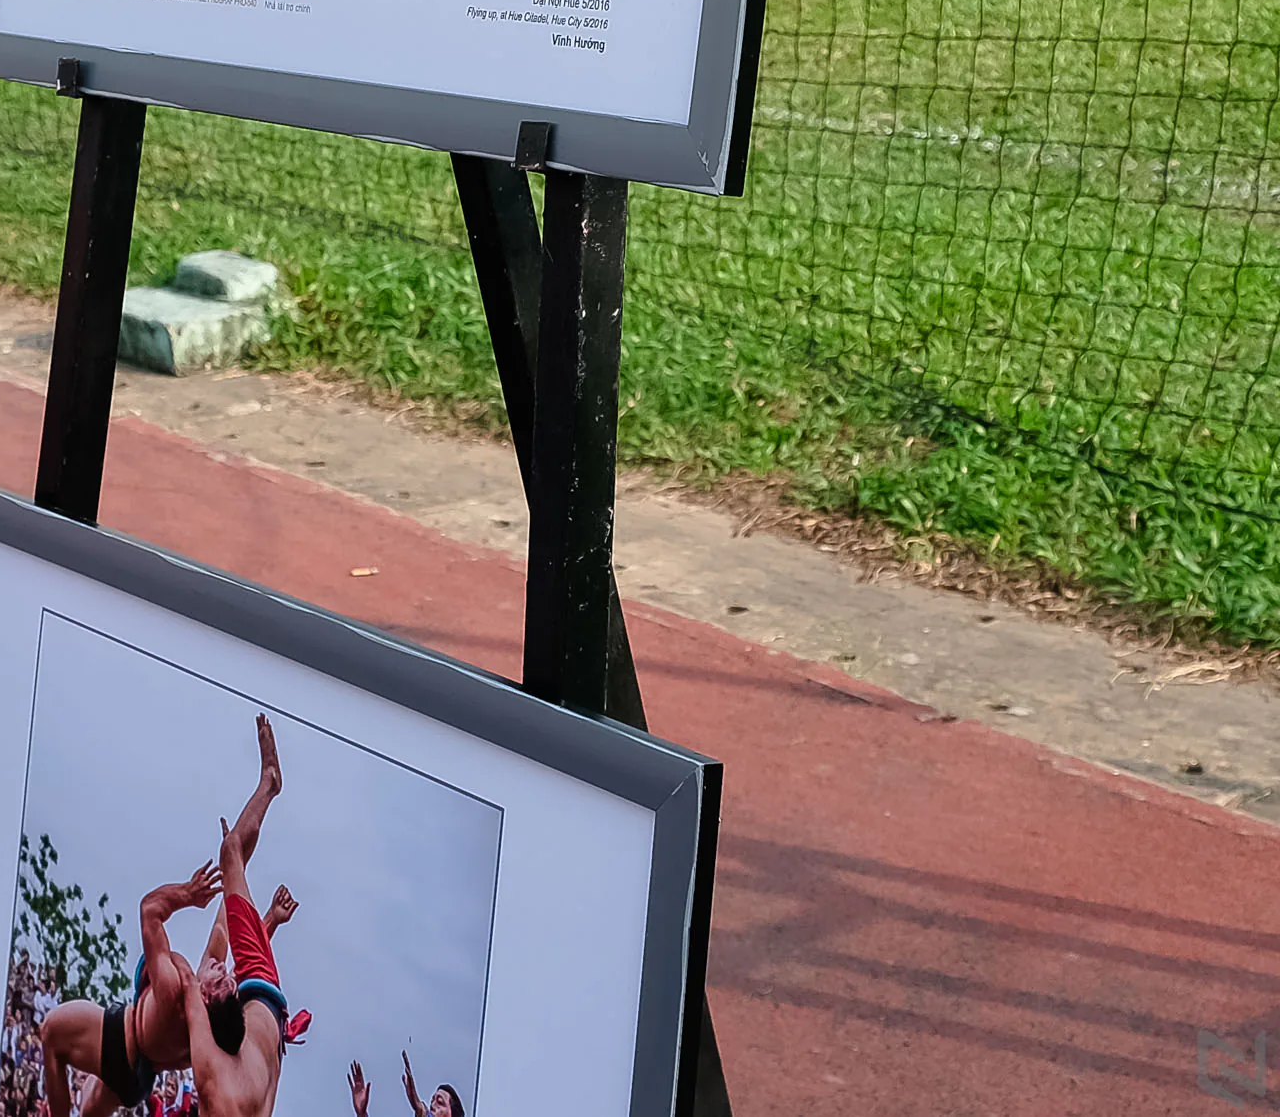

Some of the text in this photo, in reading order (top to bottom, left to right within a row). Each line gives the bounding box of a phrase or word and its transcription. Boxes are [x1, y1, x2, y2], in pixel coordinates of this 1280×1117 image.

[467, 6, 487, 20] Flying
[500, 10, 508, 20] at
[508, 11, 523, 21] Hue
[551, 14, 567, 26] Hue
[567, 16, 582, 29] City
[583, 17, 609, 29] 5/2016
